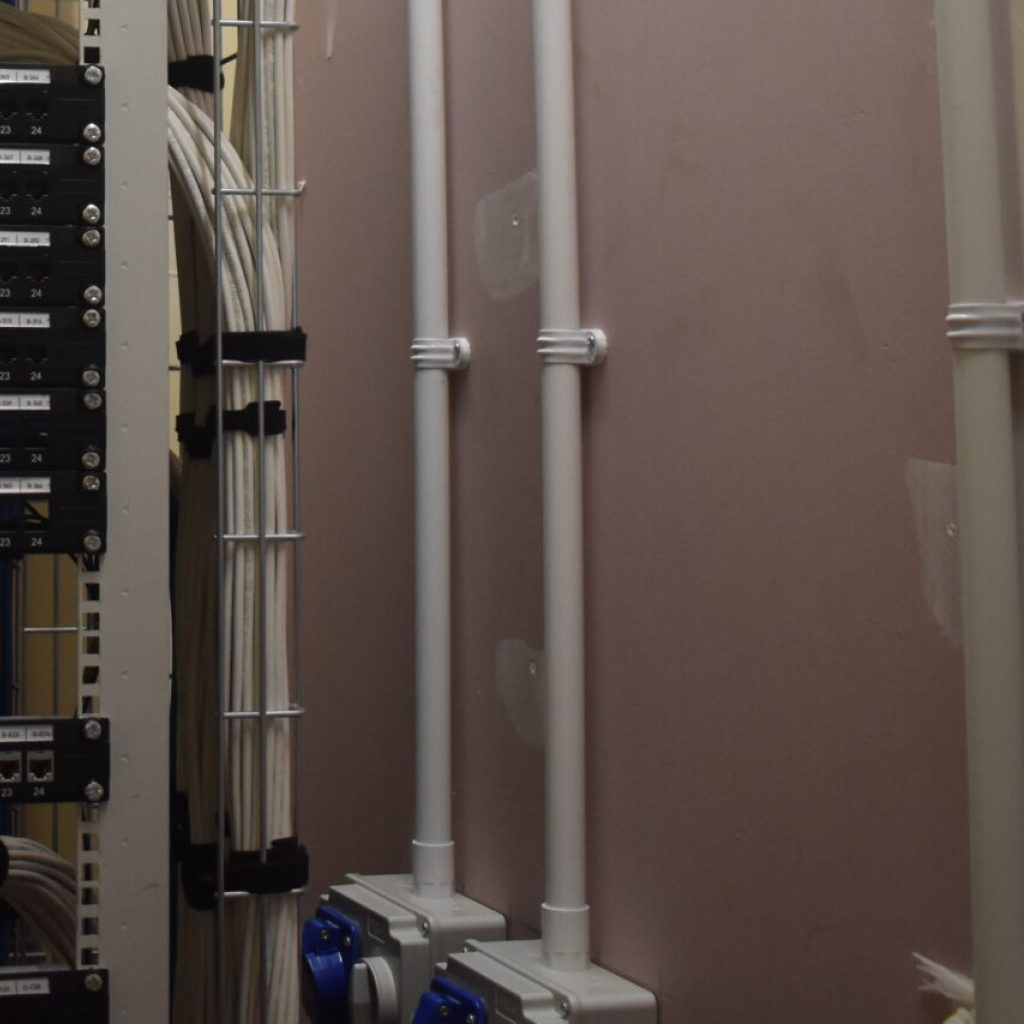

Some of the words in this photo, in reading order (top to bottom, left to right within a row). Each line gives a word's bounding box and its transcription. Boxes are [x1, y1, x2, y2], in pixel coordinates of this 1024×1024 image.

[0, 206, 11, 215] 23
[31, 206, 42, 216] 24
[30, 371, 42, 381] 24
[1, 788, 13, 797] 23
[33, 786, 45, 796] 24
